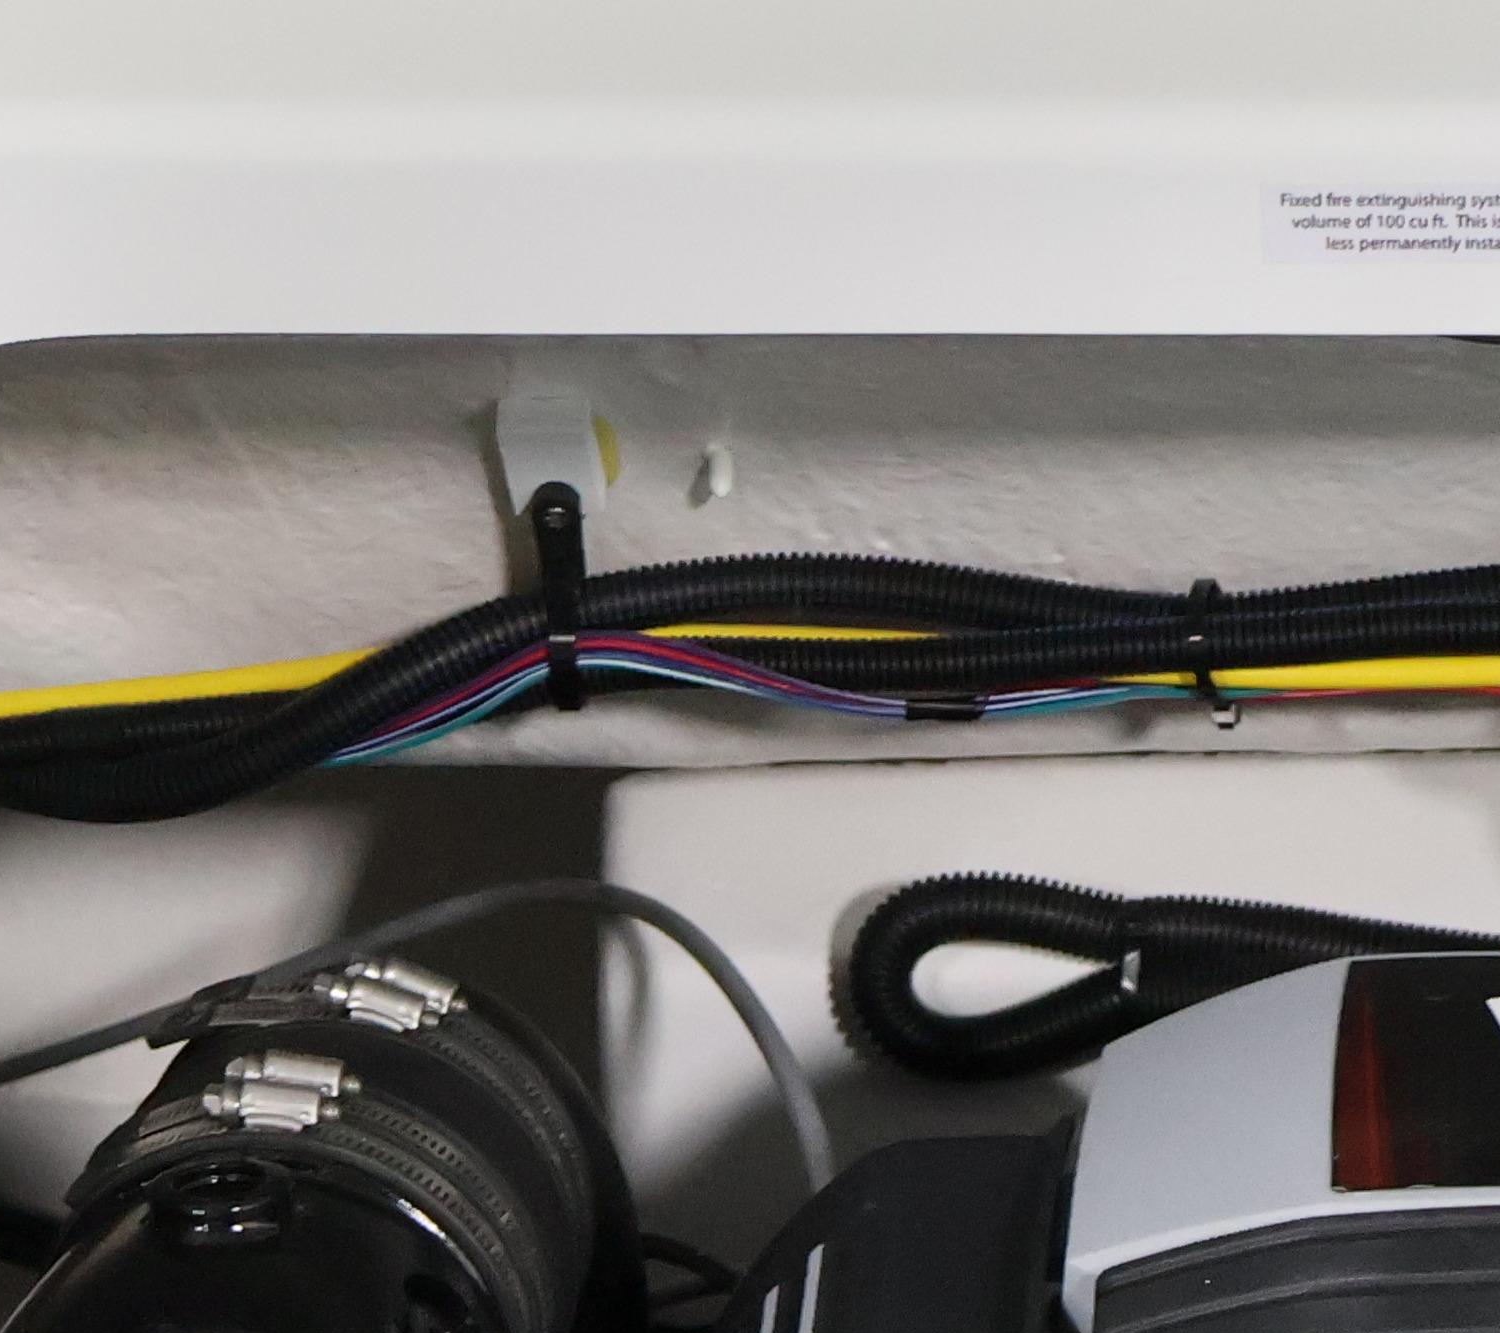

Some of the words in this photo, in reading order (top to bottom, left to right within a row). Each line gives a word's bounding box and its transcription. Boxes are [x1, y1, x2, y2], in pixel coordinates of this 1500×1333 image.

[1280, 193, 1322, 207] Fixed
[1326, 192, 1352, 207] fire
[1356, 194, 1466, 210] extinguishing
[1292, 216, 1351, 229] volume
[1355, 214, 1373, 229] of
[1377, 215, 1405, 229] 100
[1409, 217, 1428, 229] cu
[1455, 214, 1487, 228] This
[1326, 237, 1354, 250] less
[1359, 237, 1461, 252] permanently
